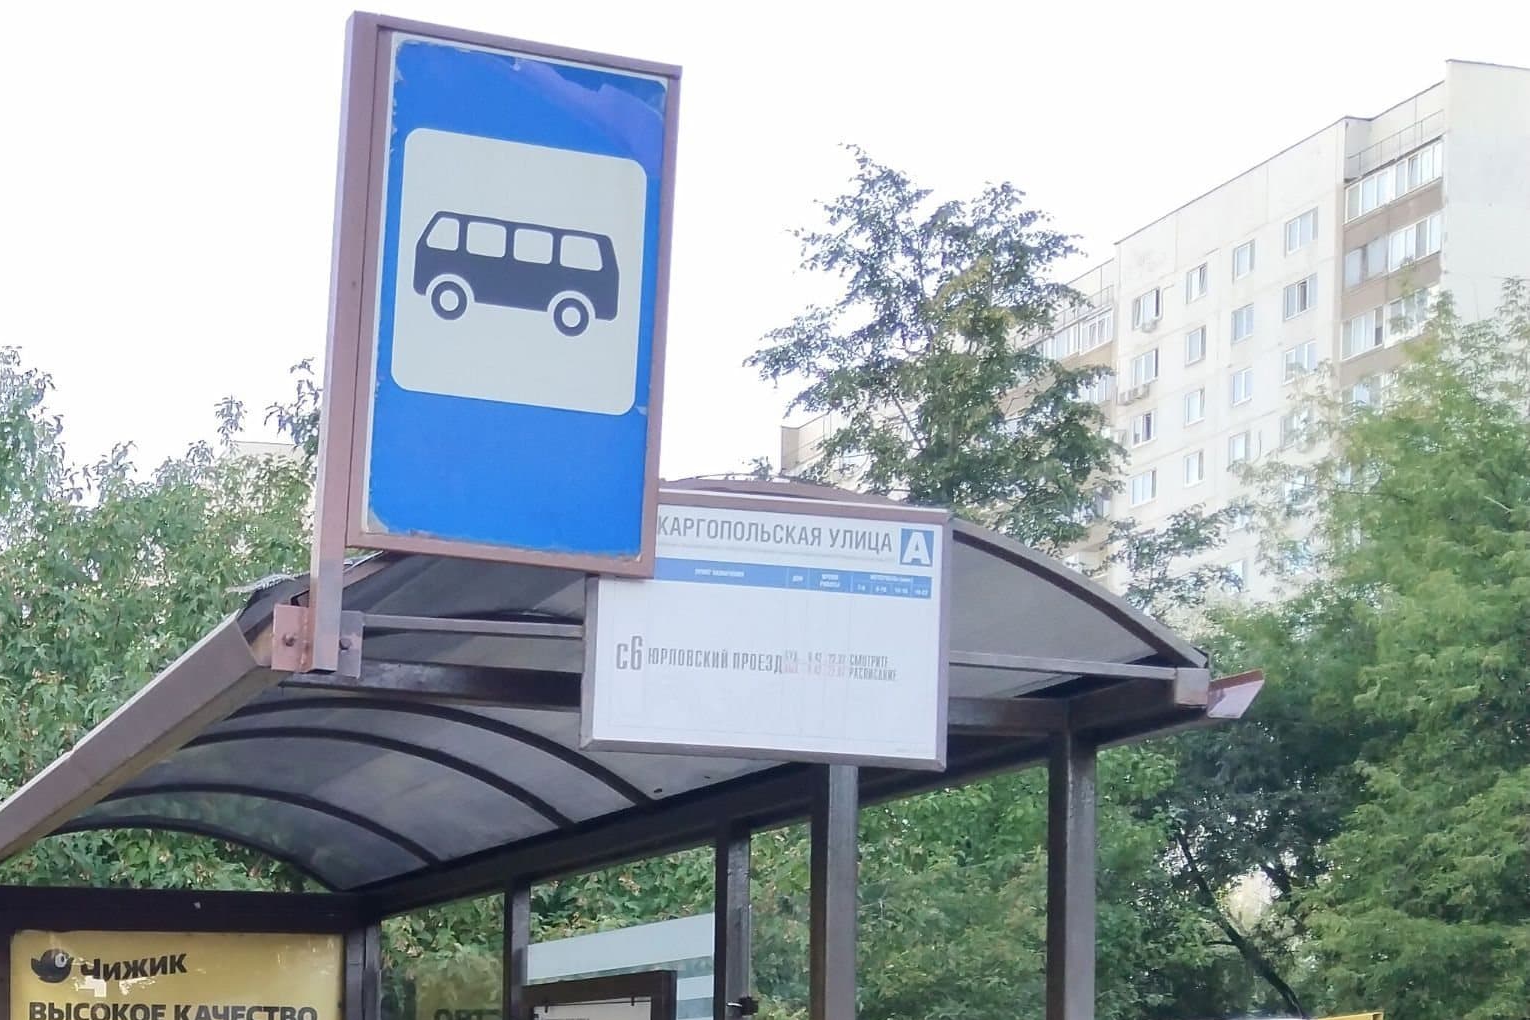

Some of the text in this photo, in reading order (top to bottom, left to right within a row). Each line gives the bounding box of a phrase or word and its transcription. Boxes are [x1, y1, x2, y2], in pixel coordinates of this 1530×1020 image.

[658, 515, 932, 565] КАРГОПОЛЬСКАЯ УЛИЦА А
[647, 647, 729, 669] ЮРЛОВСКИЙ
[733, 651, 783, 674] ПРОЕЗД
